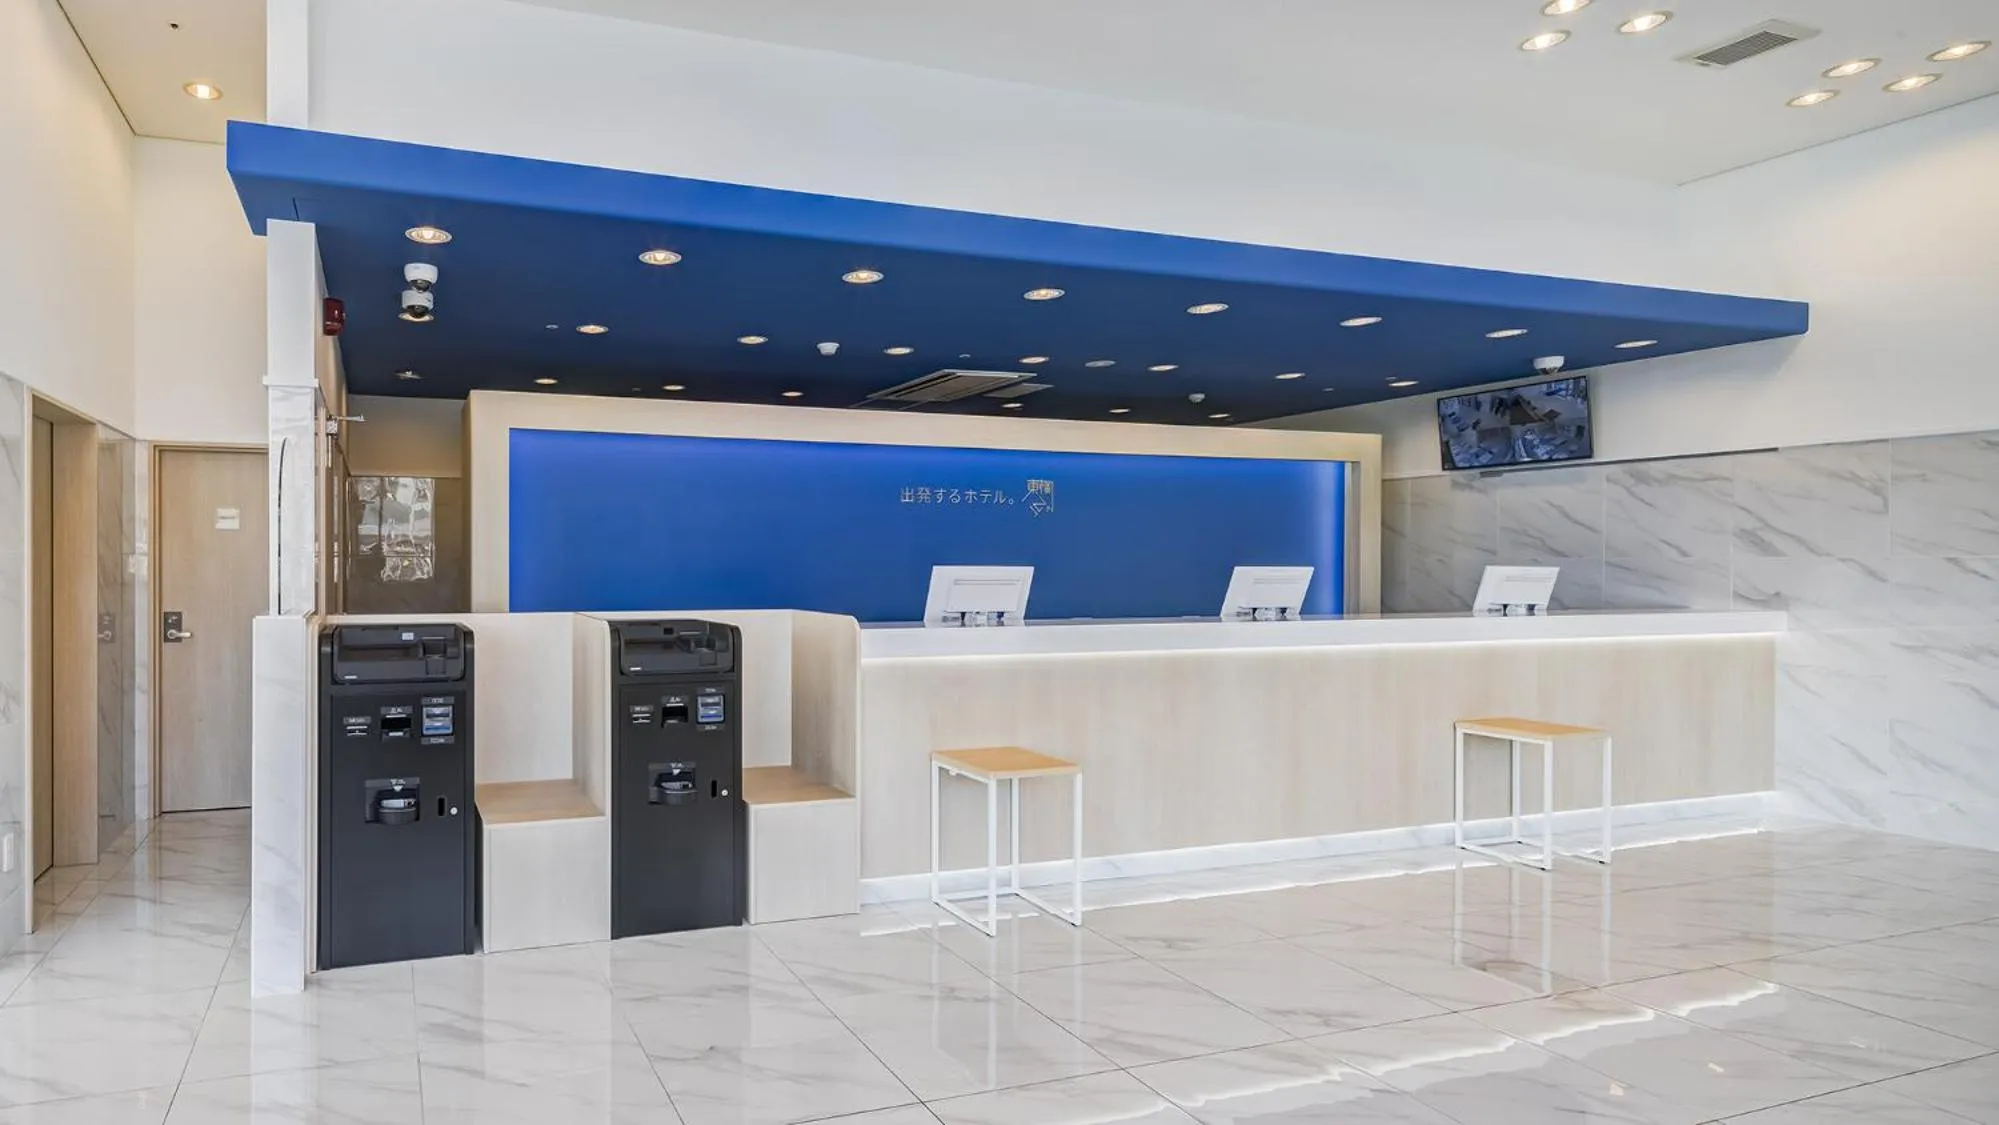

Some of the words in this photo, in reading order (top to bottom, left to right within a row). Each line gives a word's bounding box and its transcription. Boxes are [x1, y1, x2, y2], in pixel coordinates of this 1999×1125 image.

[900, 487, 1014, 504] 出発するホテル。
